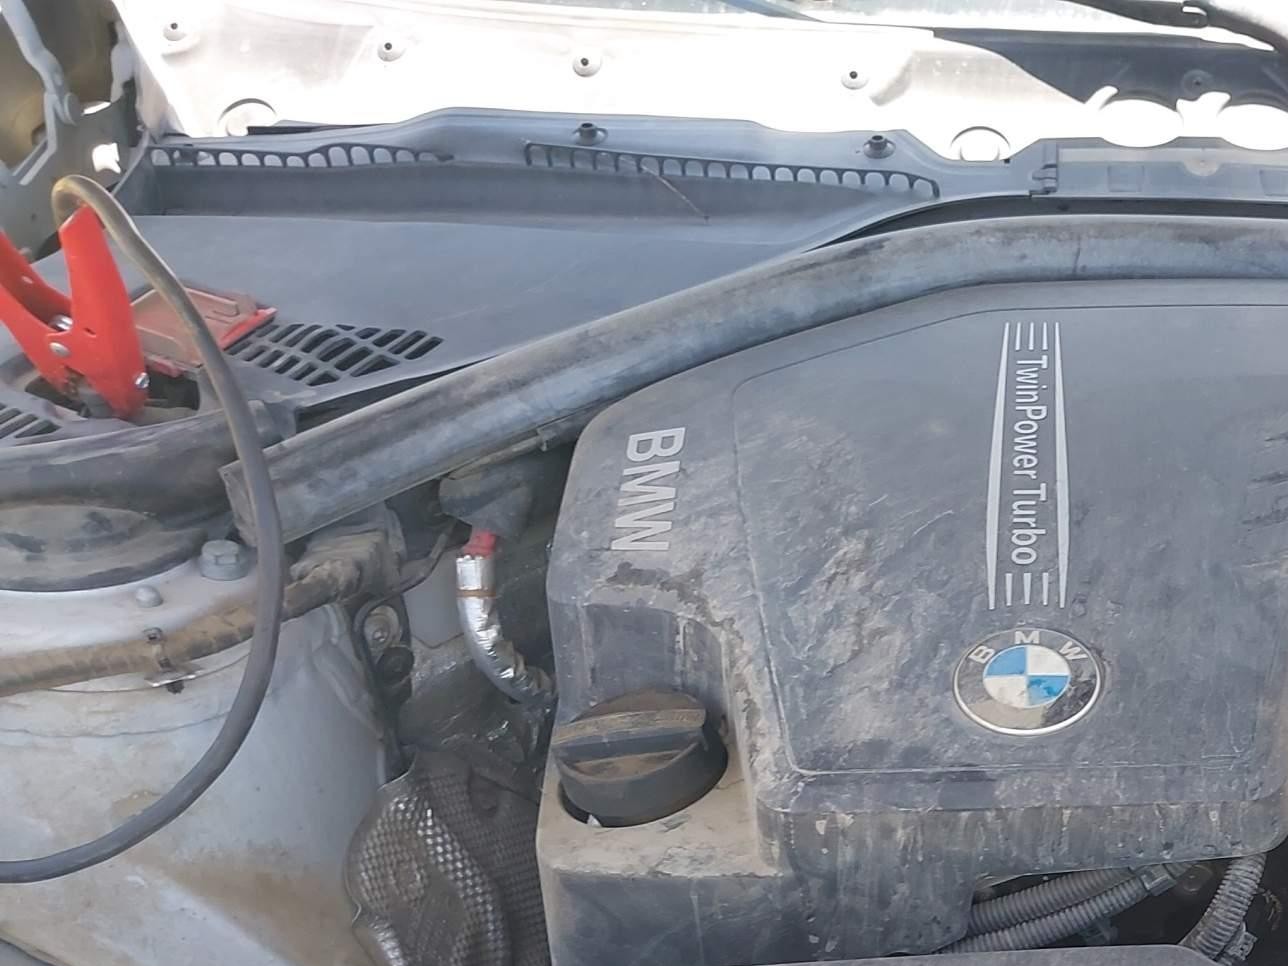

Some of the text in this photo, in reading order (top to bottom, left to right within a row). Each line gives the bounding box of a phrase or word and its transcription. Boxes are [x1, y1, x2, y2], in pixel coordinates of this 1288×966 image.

[610, 426, 687, 551] BMW
[1010, 354, 1049, 566] TwinPower Turbo
[967, 630, 1089, 664] BMW
